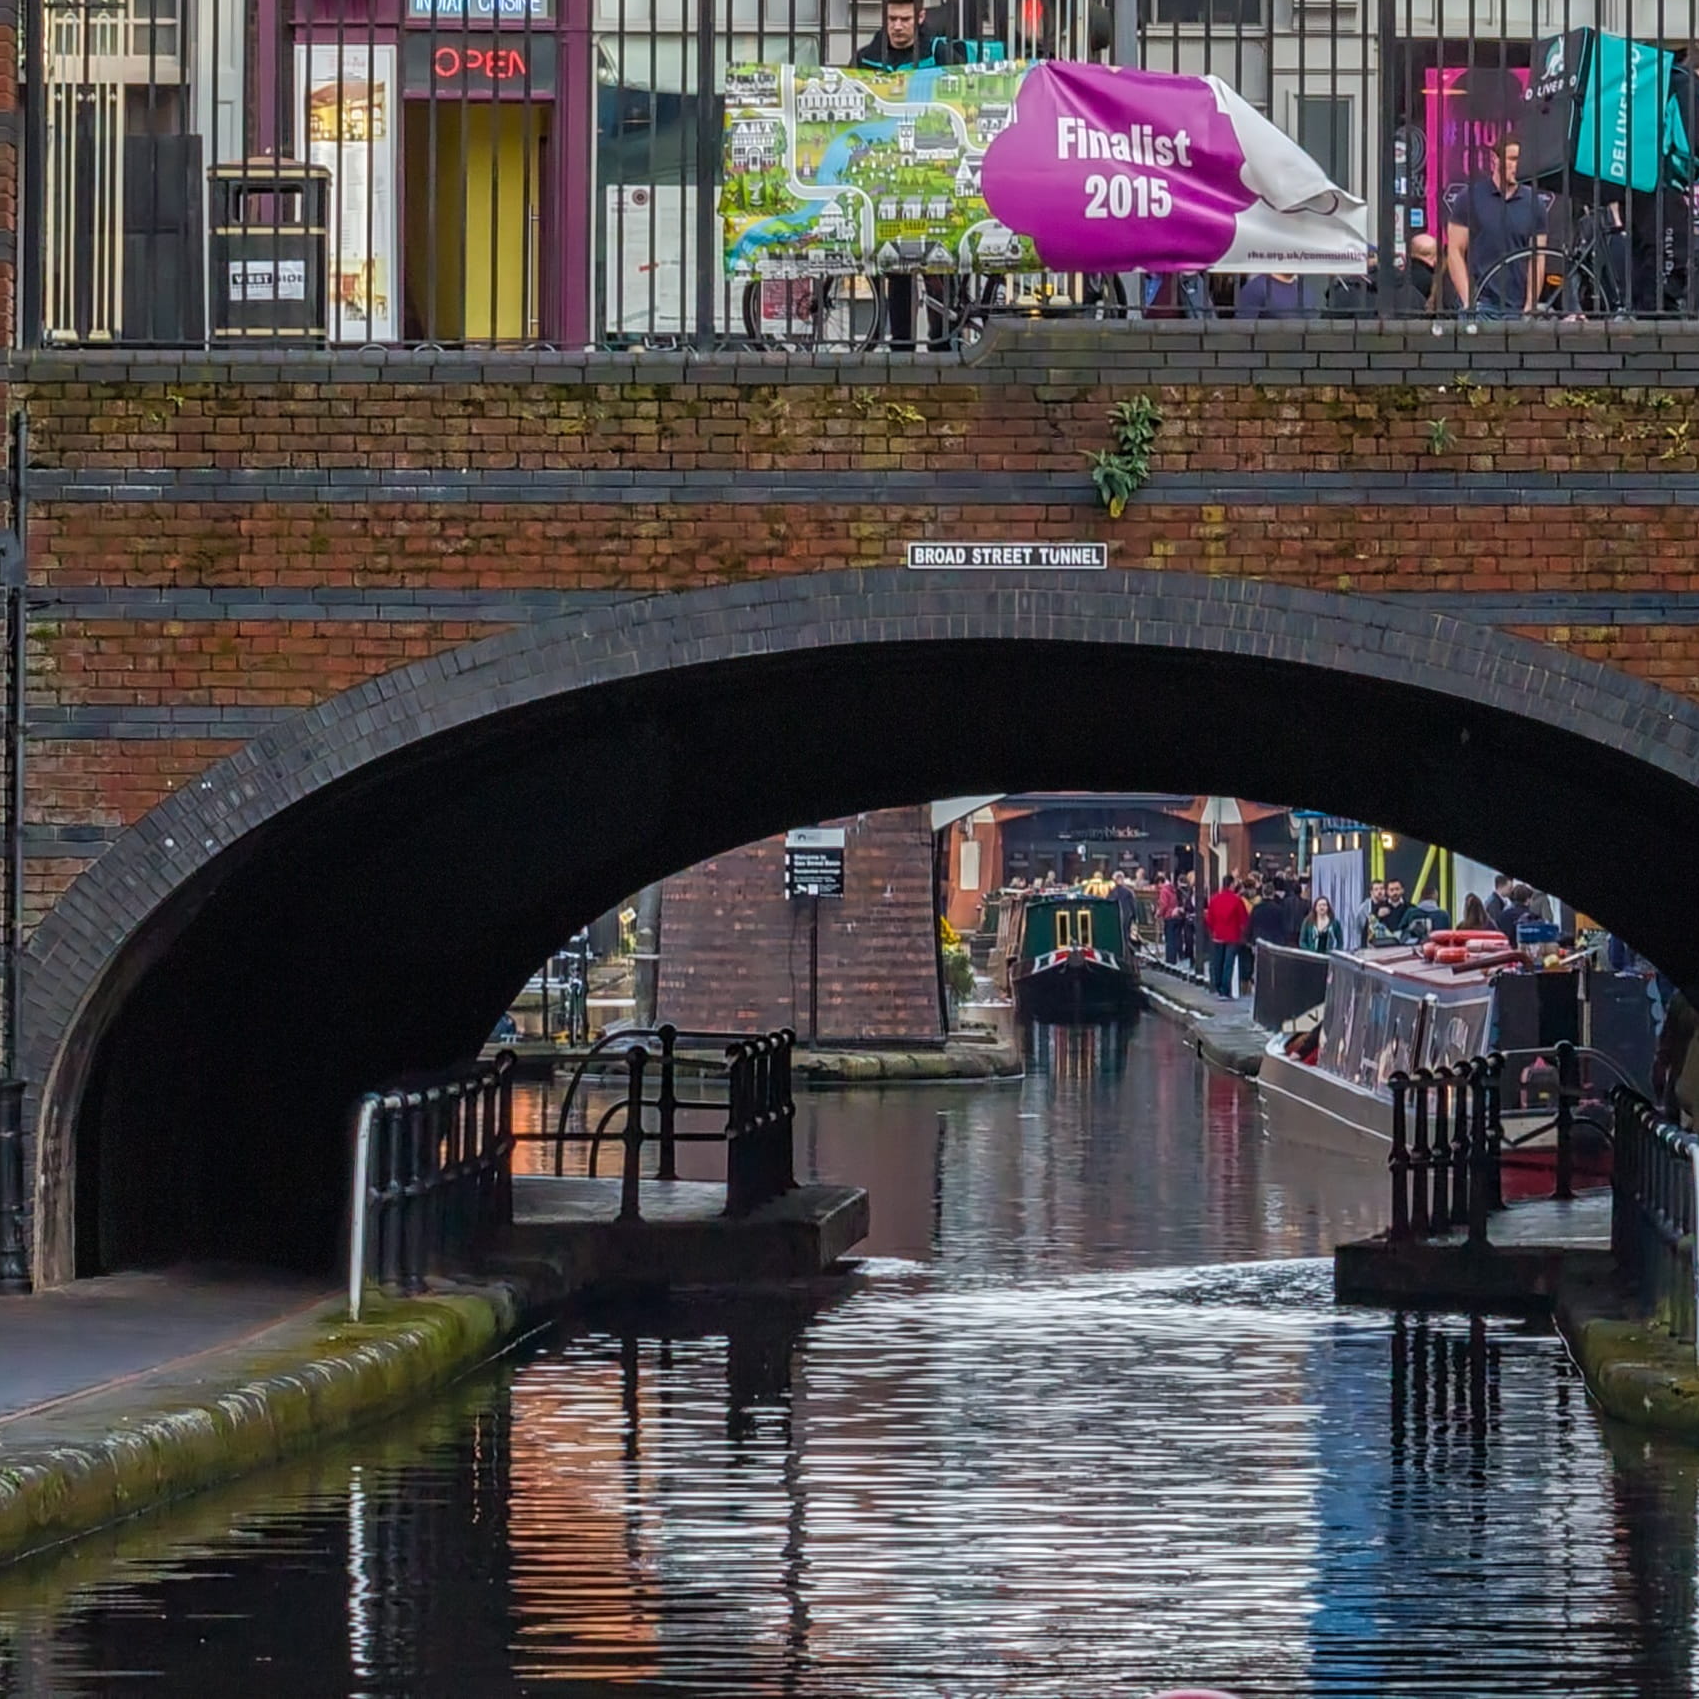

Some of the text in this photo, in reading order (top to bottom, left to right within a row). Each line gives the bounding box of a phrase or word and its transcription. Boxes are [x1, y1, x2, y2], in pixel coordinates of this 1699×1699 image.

[434, 47, 526, 78] OPEN
[1524, 74, 1577, 101] DLIVERO
[1057, 117, 1193, 168] Finalist
[1085, 174, 1173, 218] 2015
[915, 548, 1100, 564] BROAD STREET TUNNEL
